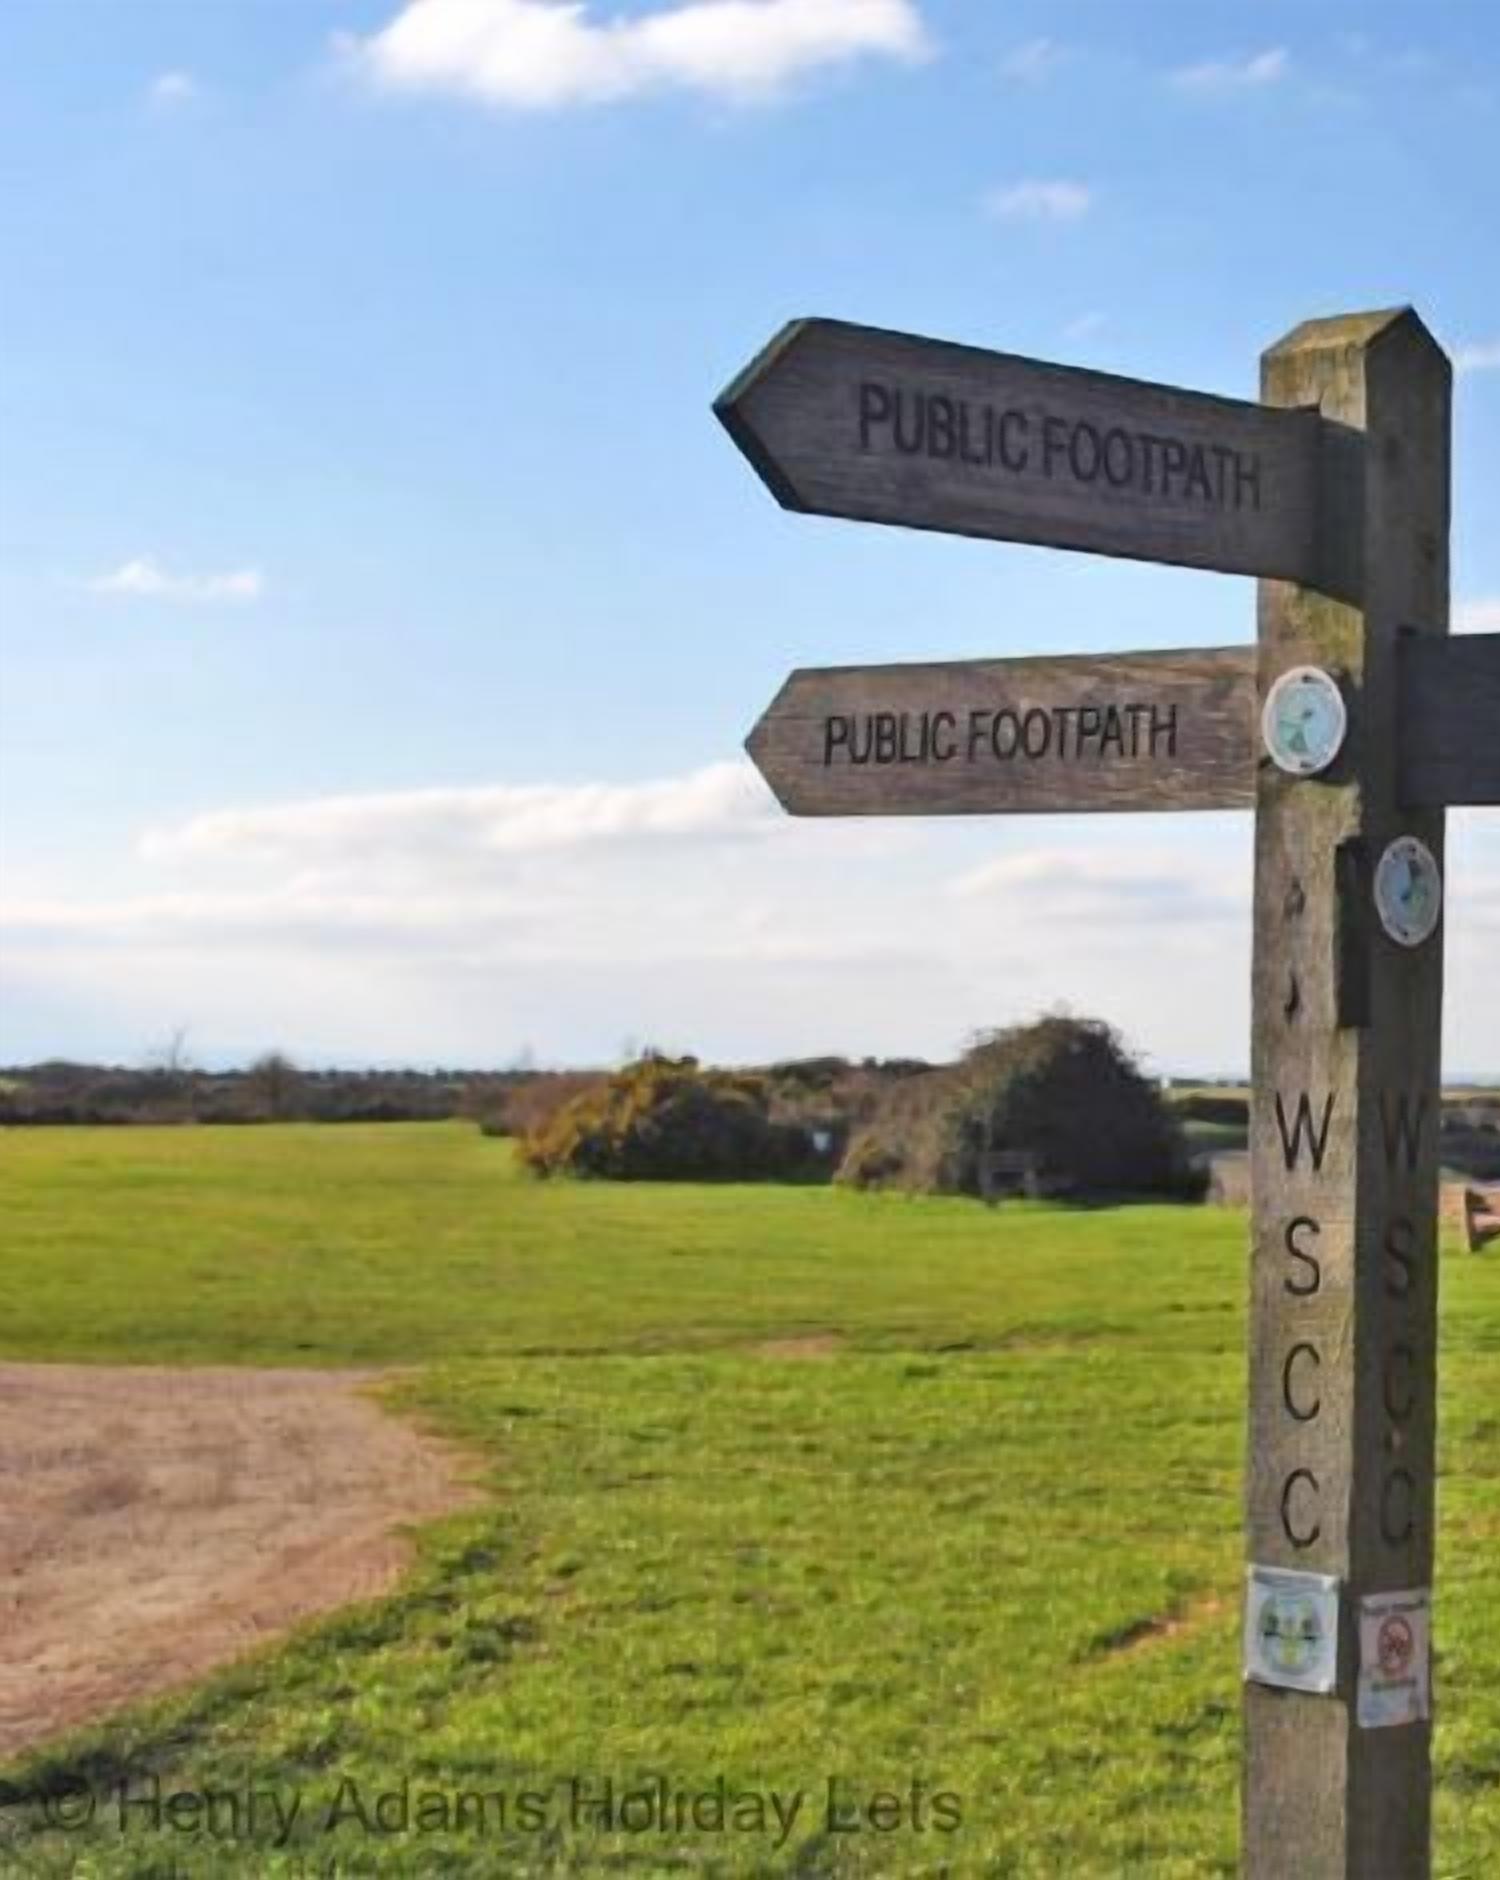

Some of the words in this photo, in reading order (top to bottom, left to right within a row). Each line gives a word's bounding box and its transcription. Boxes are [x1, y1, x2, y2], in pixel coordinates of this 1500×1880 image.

[858, 383, 1028, 471] PUBLIC
[1044, 417, 1260, 509] FOOTPATH
[823, 713, 957, 766] PUBLIC
[966, 703, 1177, 760] FOOTPATH
